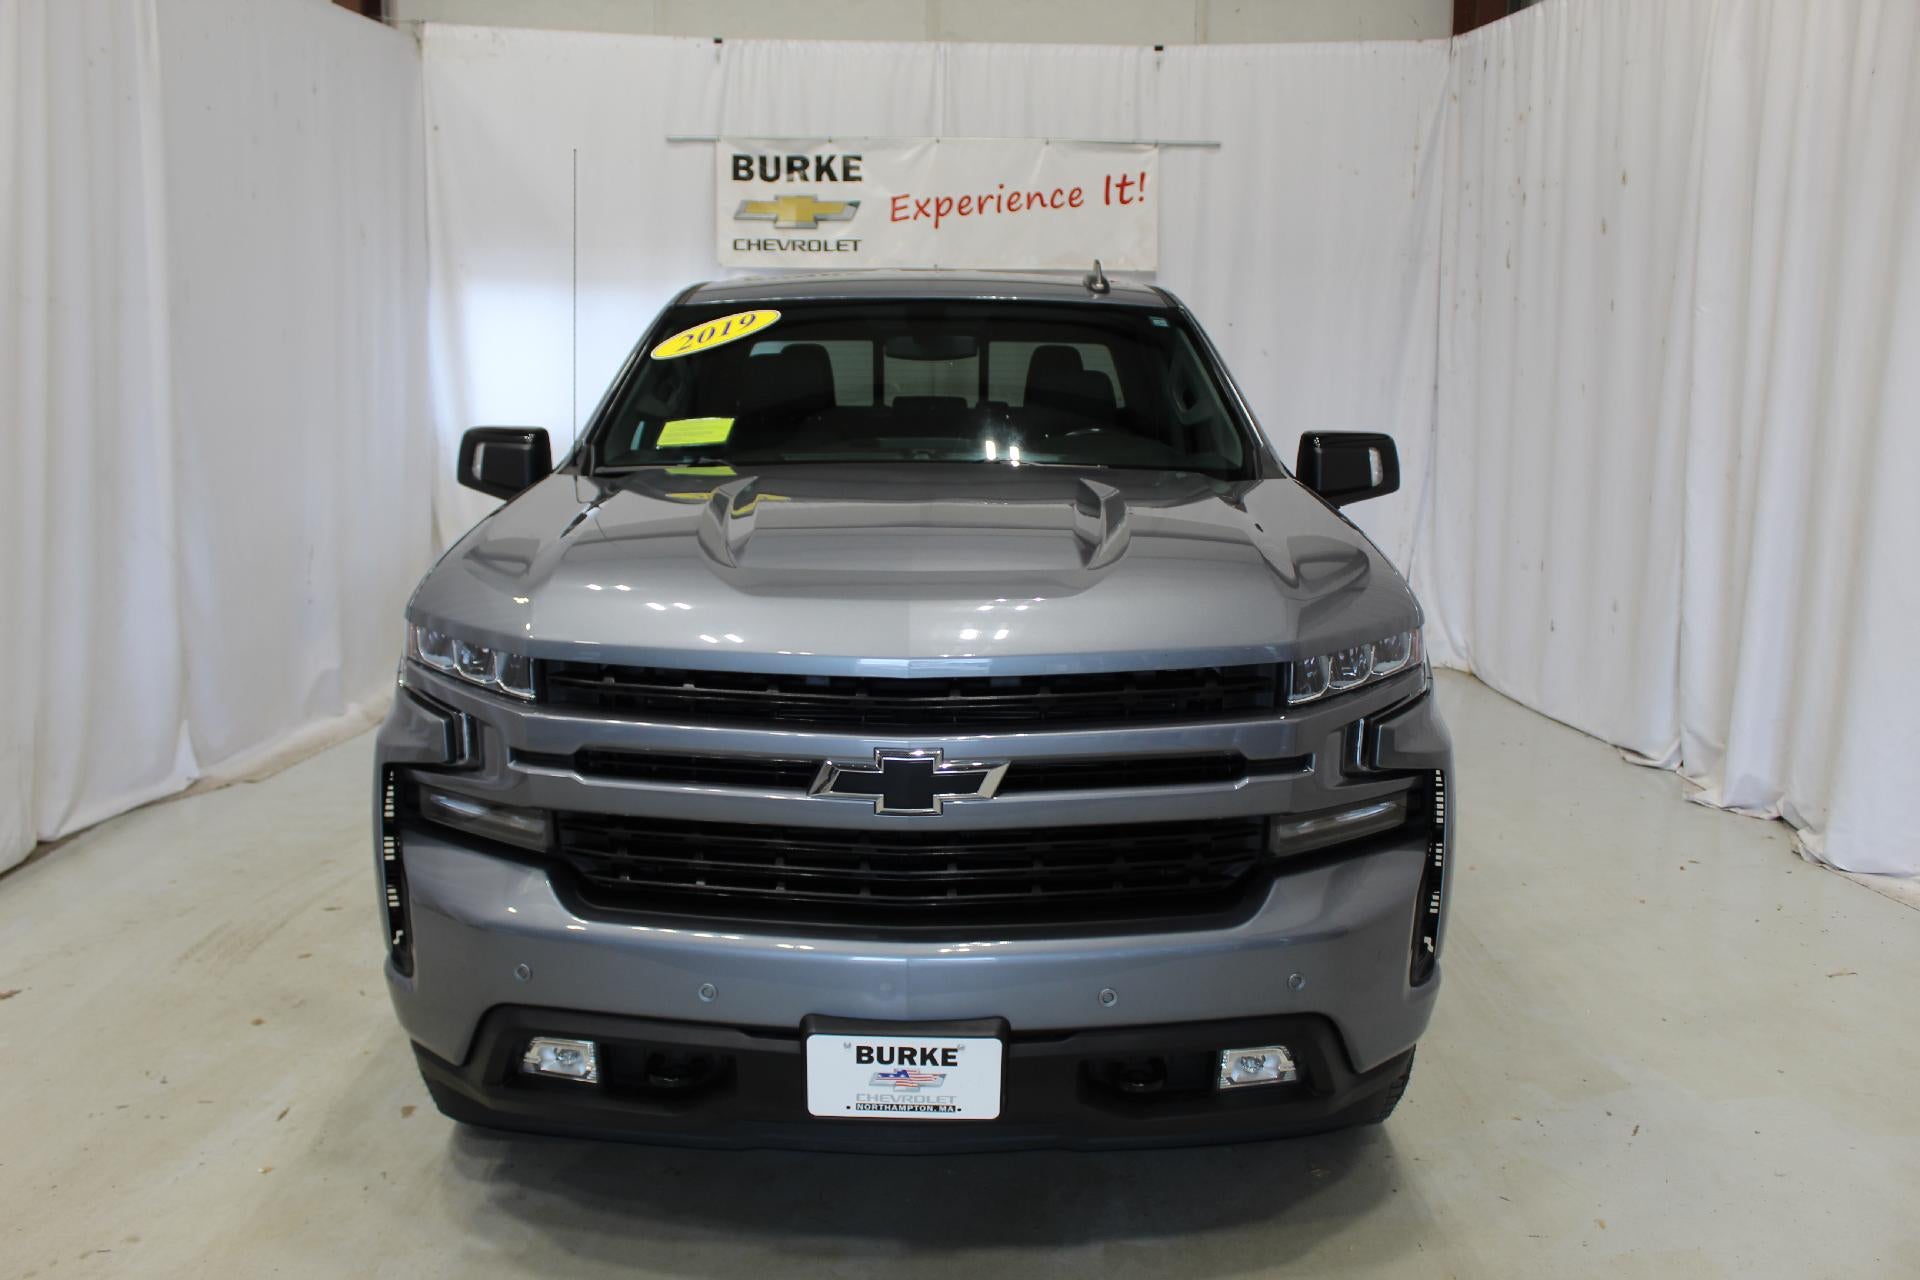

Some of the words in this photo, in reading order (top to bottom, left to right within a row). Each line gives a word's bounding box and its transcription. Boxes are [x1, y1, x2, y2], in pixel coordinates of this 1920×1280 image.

[732, 154, 862, 182] BURKE
[890, 184, 1084, 229] Experience
[1103, 172, 1146, 206] It!
[732, 238, 862, 252] CHEVROLET
[676, 313, 756, 351] 2019
[855, 1045, 958, 1066] BURKE
[855, 1093, 957, 1104] CHEVROLET
[940, 1104, 956, 1112] MA
